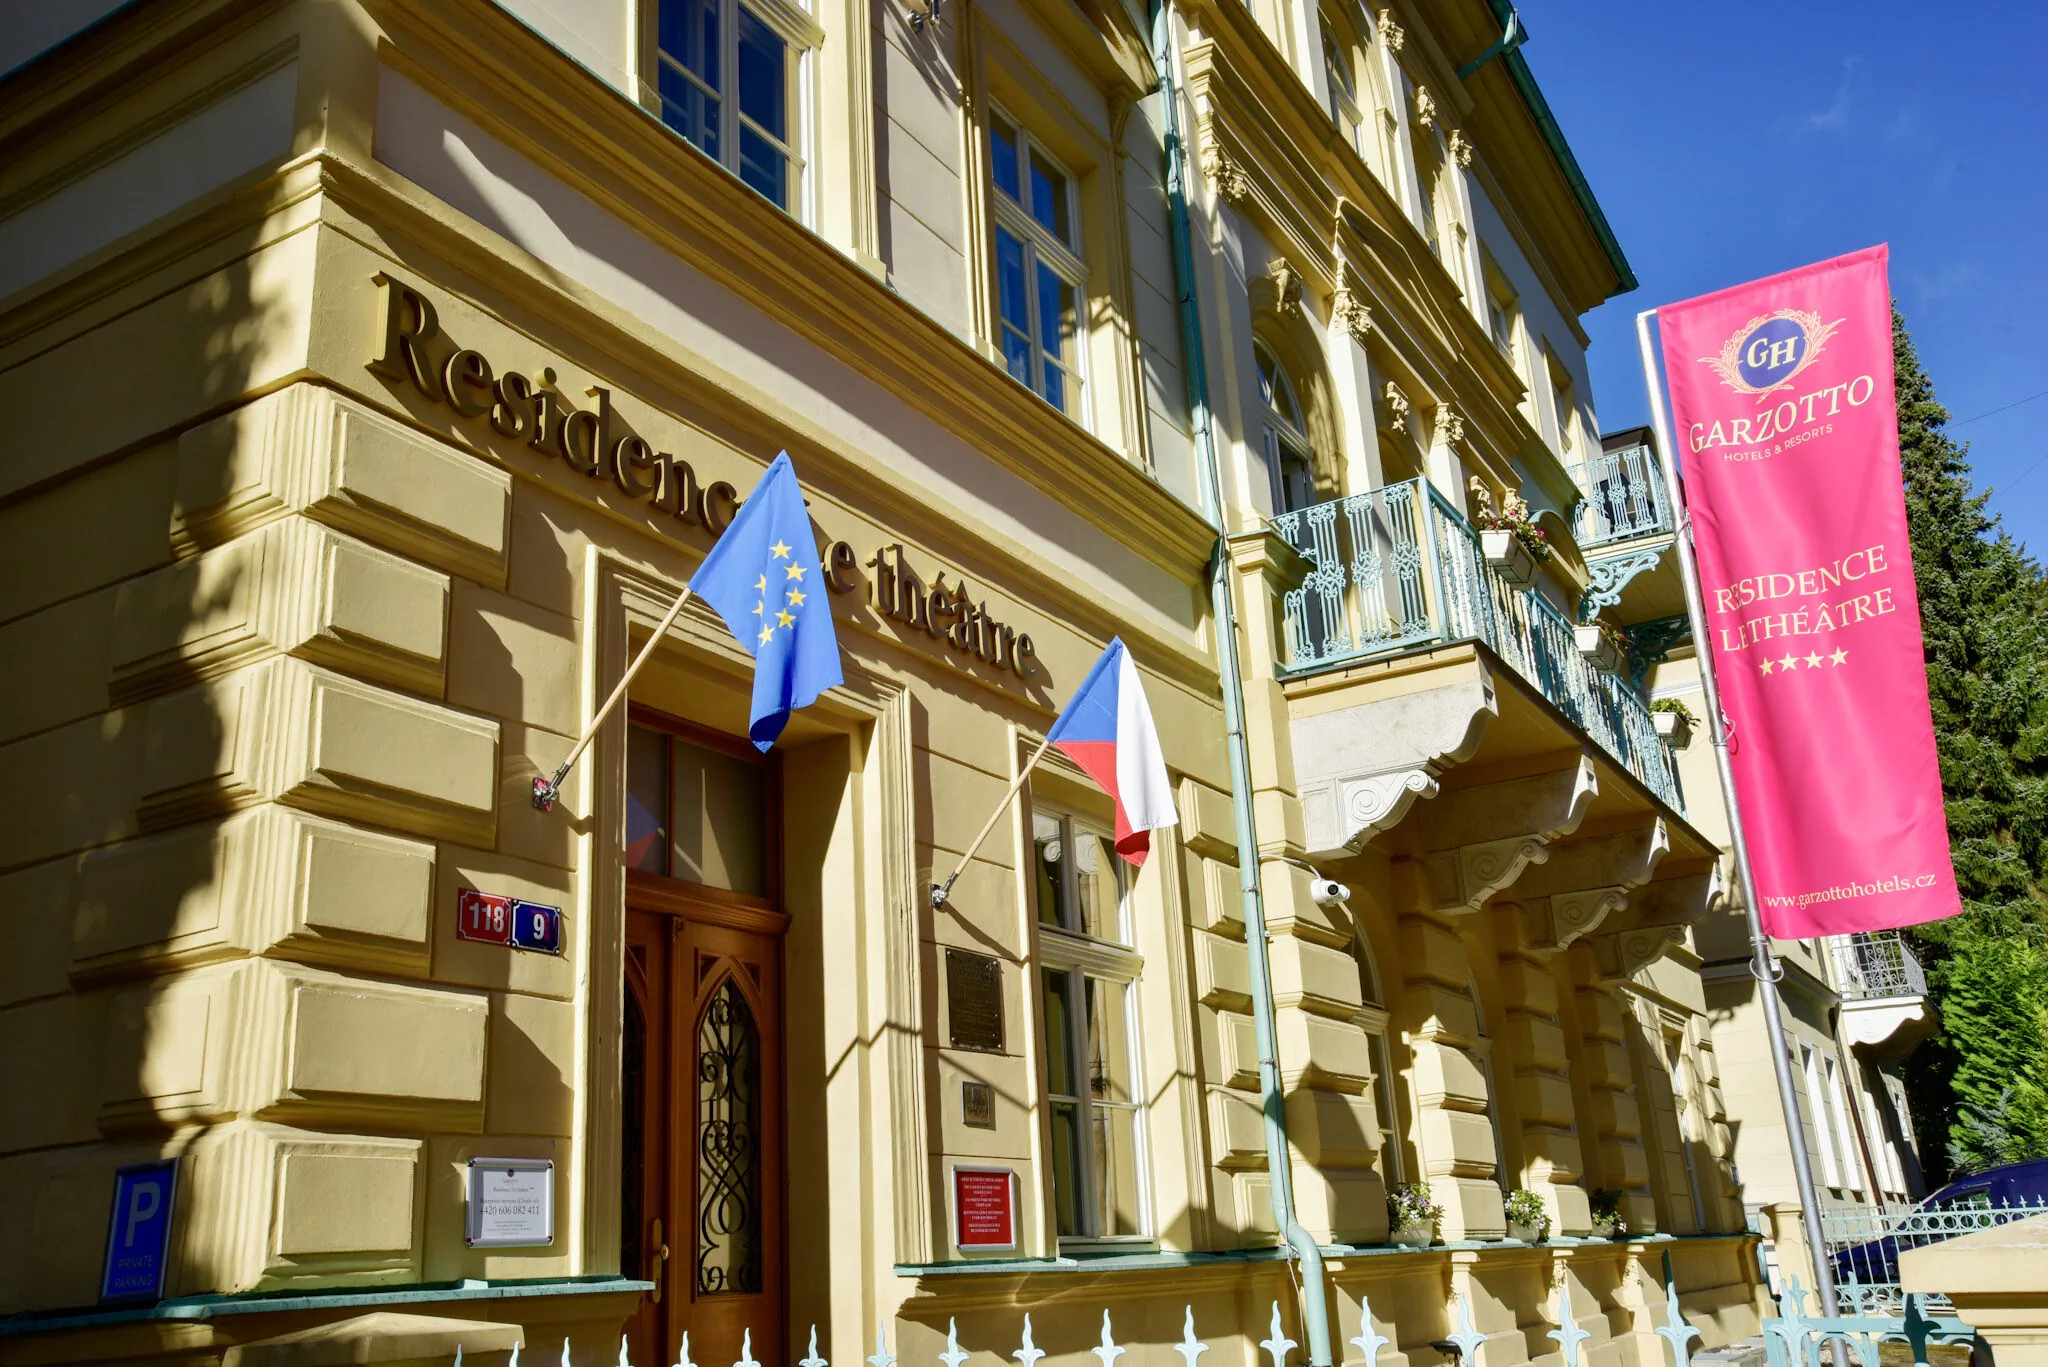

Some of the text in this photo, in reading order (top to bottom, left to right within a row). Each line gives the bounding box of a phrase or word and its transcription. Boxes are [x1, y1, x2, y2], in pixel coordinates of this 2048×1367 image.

[1747, 336, 1798, 370] GH
[1689, 375, 1875, 453] GARZOTTO
[1724, 423, 1833, 463] HOTELS & RESORTS
[364, 270, 751, 539] Residenc
[866, 543, 1036, 681] théâtre
[1713, 545, 1888, 614] RESIDENCE
[1719, 587, 1896, 651] LE THÉÂTRE
[1764, 873, 1937, 911] ww.garzottohotels.cz
[469, 902, 505, 933] 118
[533, 913, 545, 940] 9
[124, 1181, 161, 1248] P
[498, 1206, 512, 1215] 606
[512, 1206, 526, 1215] 082
[527, 1205, 540, 1215] 411
[114, 1274, 153, 1289] PARKING
[118, 1255, 154, 1270] PRIVATE
